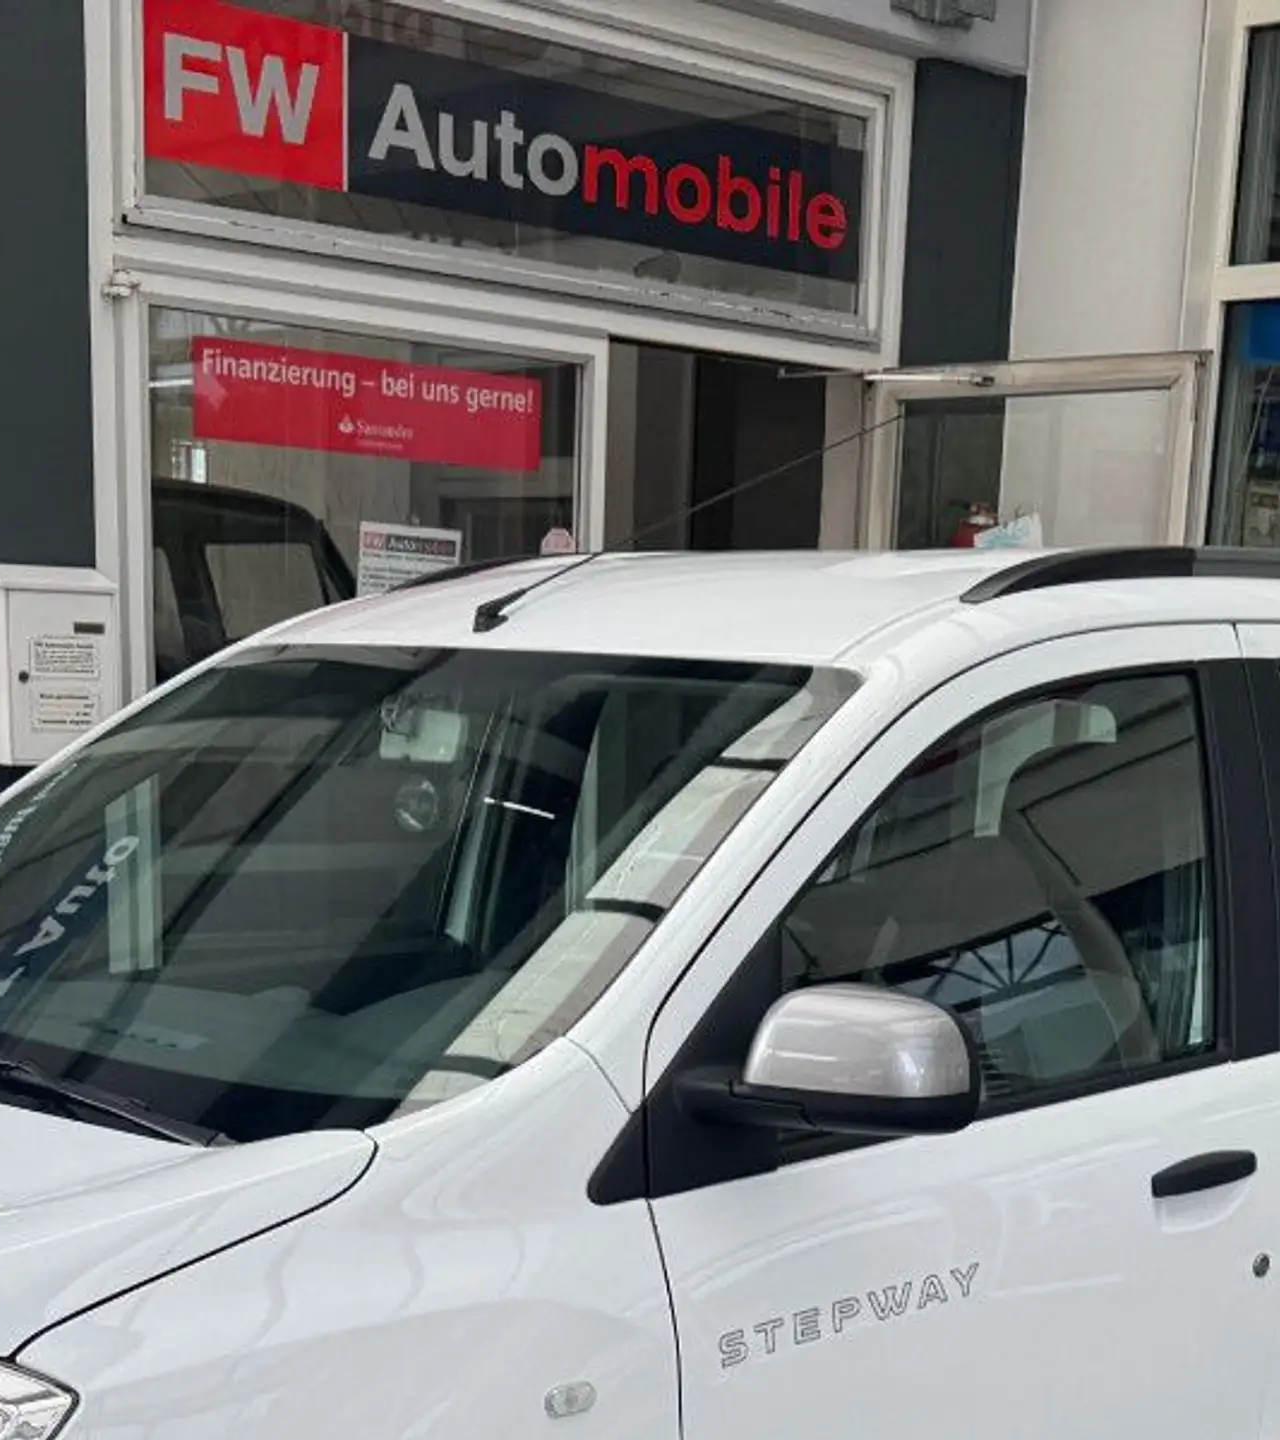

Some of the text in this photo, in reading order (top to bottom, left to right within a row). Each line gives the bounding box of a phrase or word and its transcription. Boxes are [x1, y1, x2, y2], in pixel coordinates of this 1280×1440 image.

[163, 32, 848, 250] FW Automobile
[201, 348, 356, 397] Finanzierung
[381, 369, 415, 399] bei
[421, 381, 460, 402] uns
[466, 389, 534, 413] gerne!
[717, 1261, 980, 1369] STEPWAY
